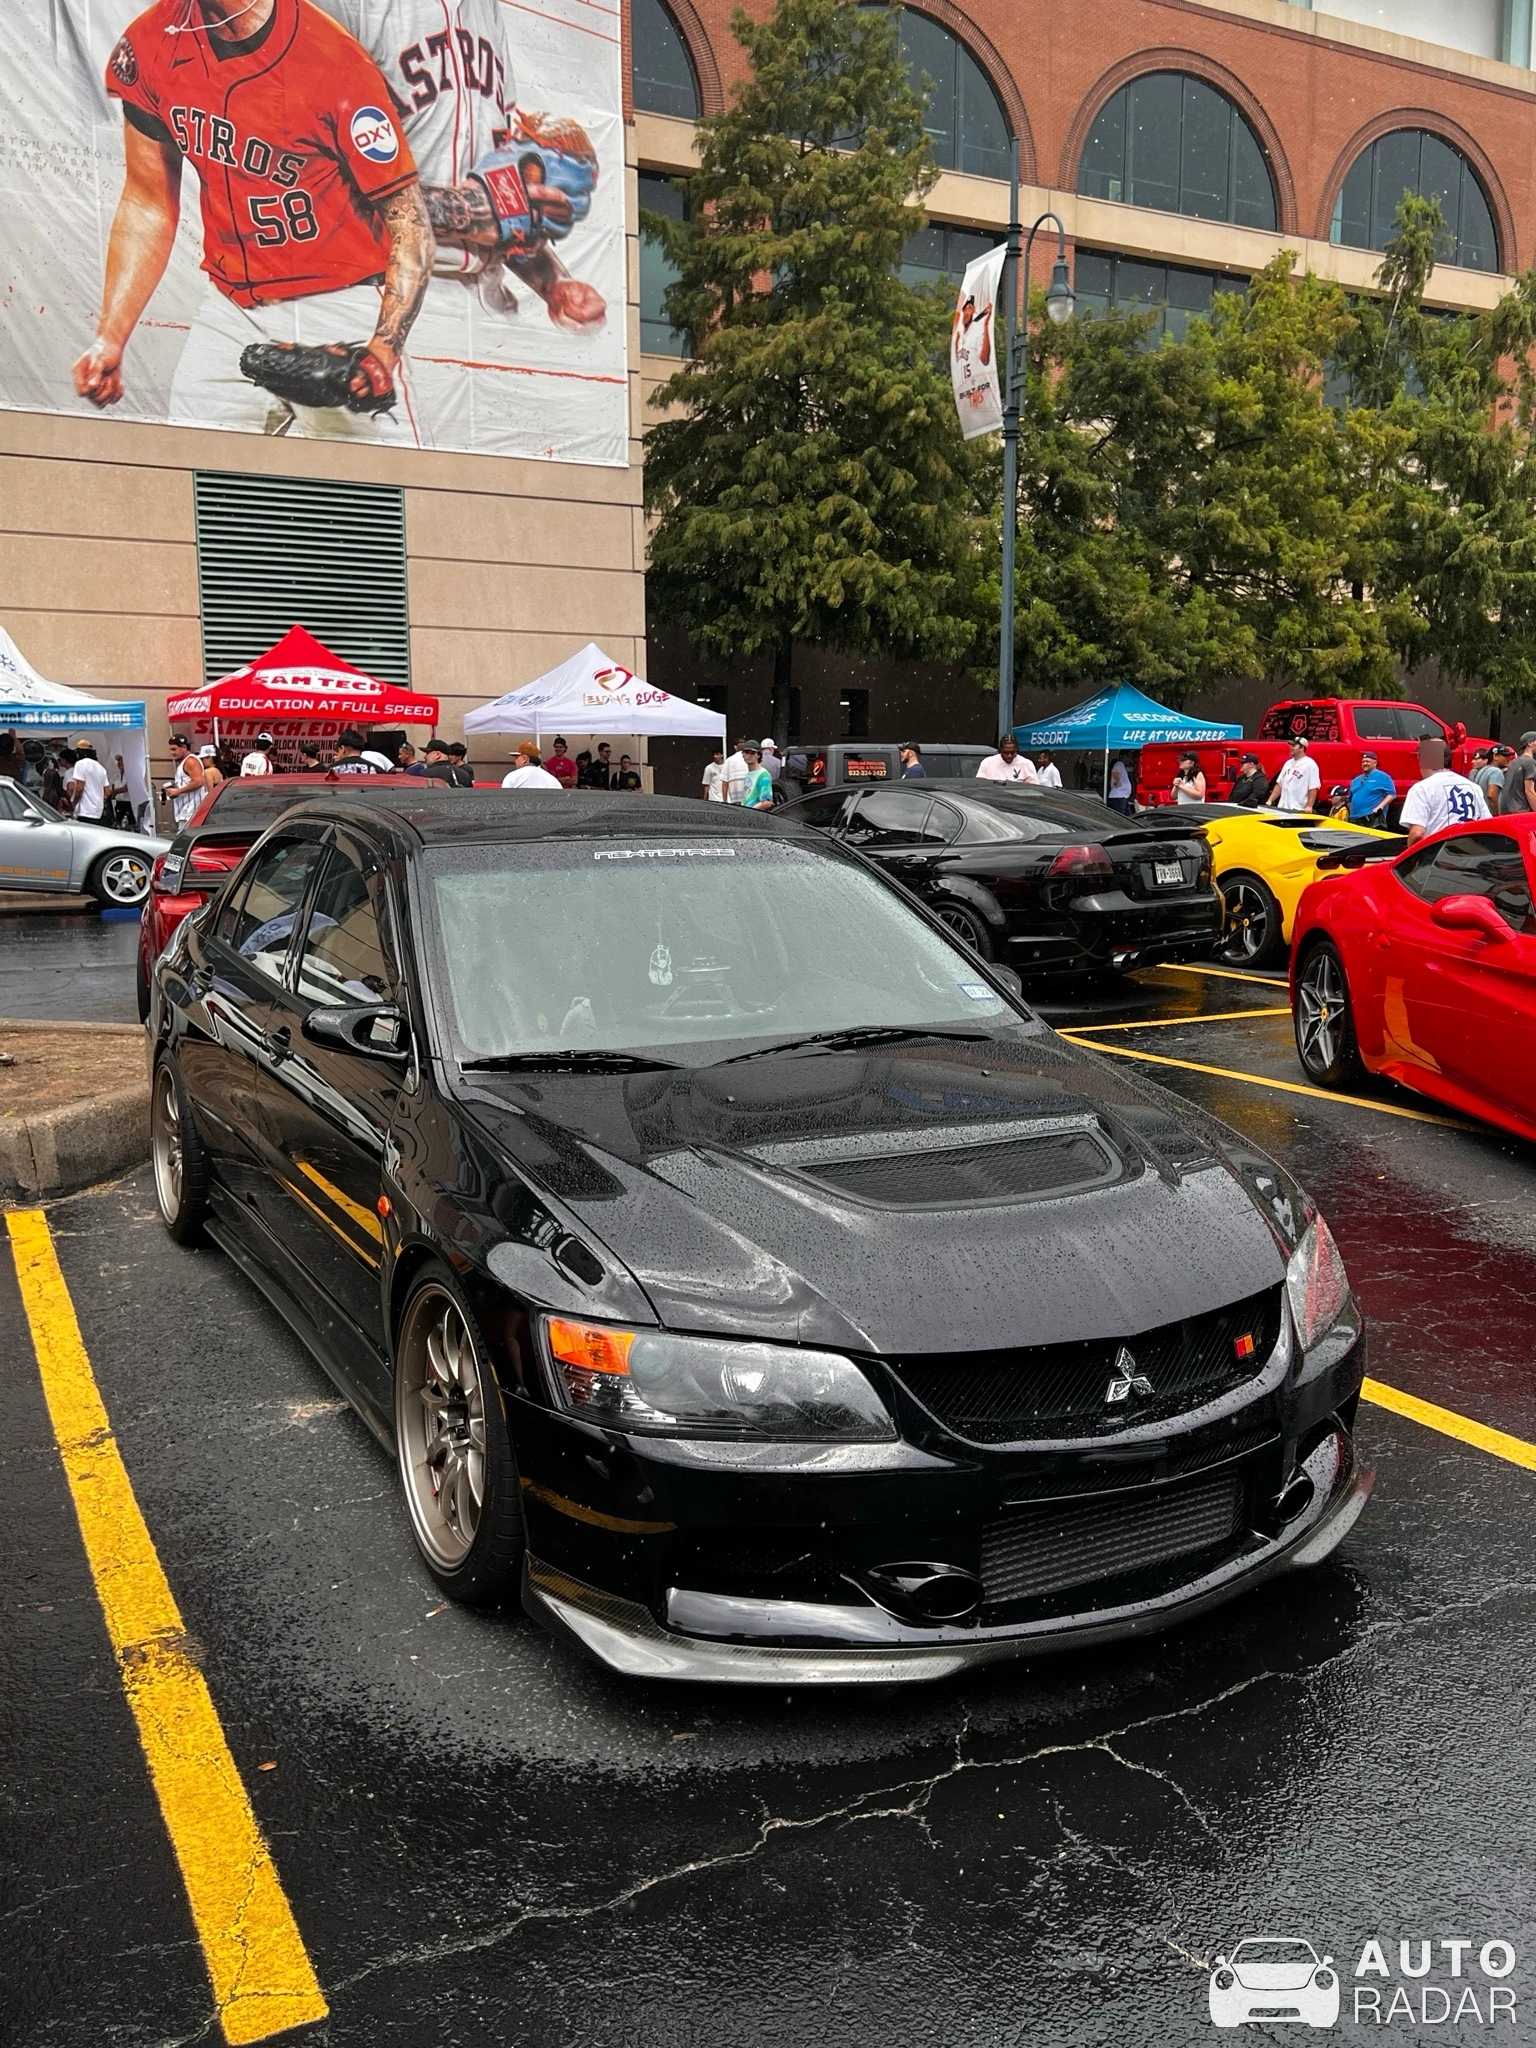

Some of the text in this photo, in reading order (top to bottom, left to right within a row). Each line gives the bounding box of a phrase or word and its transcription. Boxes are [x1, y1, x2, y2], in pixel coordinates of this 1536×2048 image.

[354, 122, 393, 149] OXY
[169, 106, 306, 188] STROS
[54, 166, 93, 180] PARK
[248, 189, 319, 248] 58
[251, 676, 311, 685] SAM
[318, 678, 387, 693] TECH
[218, 698, 434, 716] EDUCATION AT FULL SPEED
[24, 712, 39, 724] of
[41, 712, 66, 724] Car
[68, 712, 131, 726] Detailing
[1122, 713, 1182, 723] ESCORT
[1031, 731, 1070, 745] ESCORT
[1123, 730, 1147, 742] LIFE
[1148, 730, 1164, 741] AT
[1165, 730, 1194, 741] YOUR
[274, 740, 298, 750] BLOCK
